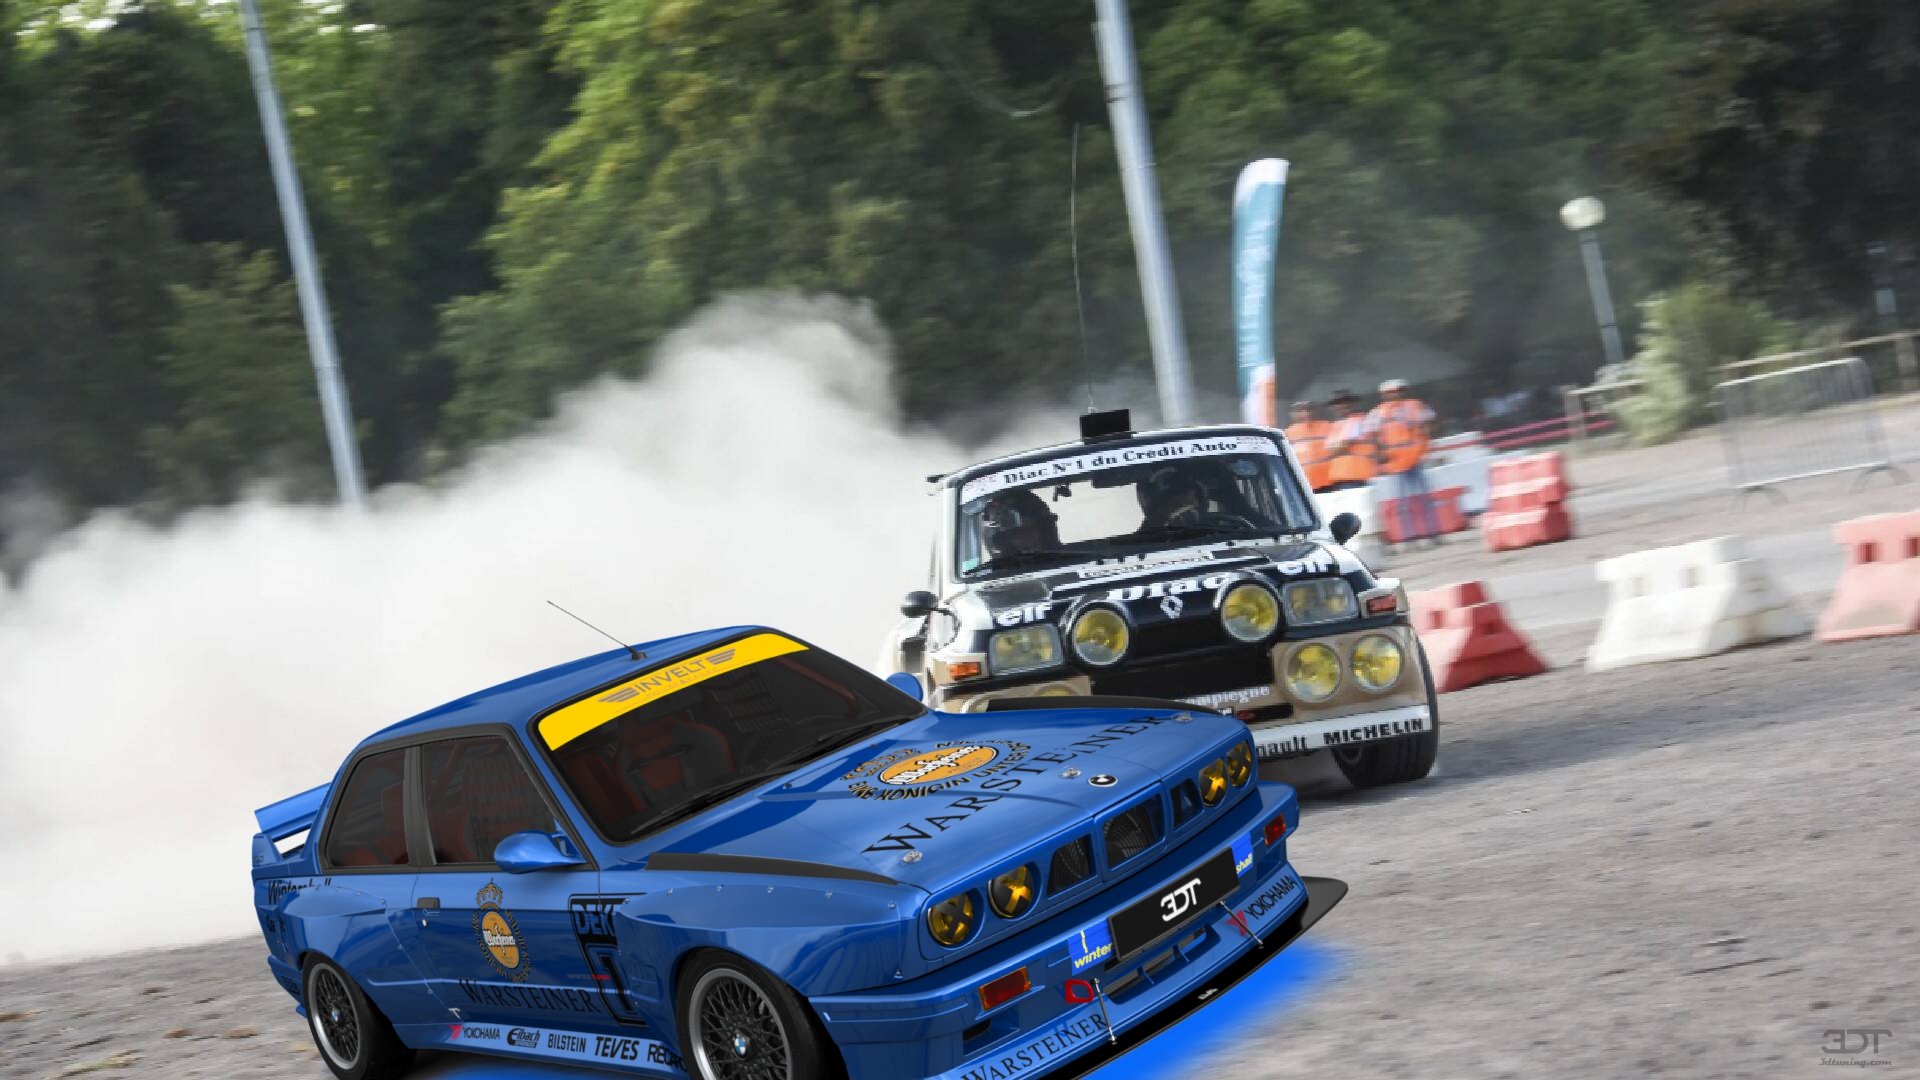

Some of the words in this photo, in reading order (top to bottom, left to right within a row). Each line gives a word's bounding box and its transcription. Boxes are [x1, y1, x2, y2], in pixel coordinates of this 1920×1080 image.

[1004, 468, 1048, 484] Diac
[1091, 455, 1118, 467] du
[1190, 441, 1237, 454] Auto
[1278, 555, 1330, 575] elf
[996, 601, 1051, 627] elf
[634, 658, 707, 693] INVELT
[1323, 718, 1422, 745] MICHELIN
[861, 714, 1172, 855] WARSTEINER
[1244, 875, 1298, 921] YOKOHAMA
[1074, 941, 1114, 969] winter
[458, 977, 602, 1014] WARSTEINER
[462, 1026, 501, 1041] YOKOHAMA
[506, 1027, 541, 1047] Eibach
[547, 1033, 587, 1053] BILSTEIN
[961, 1011, 1108, 1080] WARSTEINER
[595, 1036, 640, 1061] TEVES
